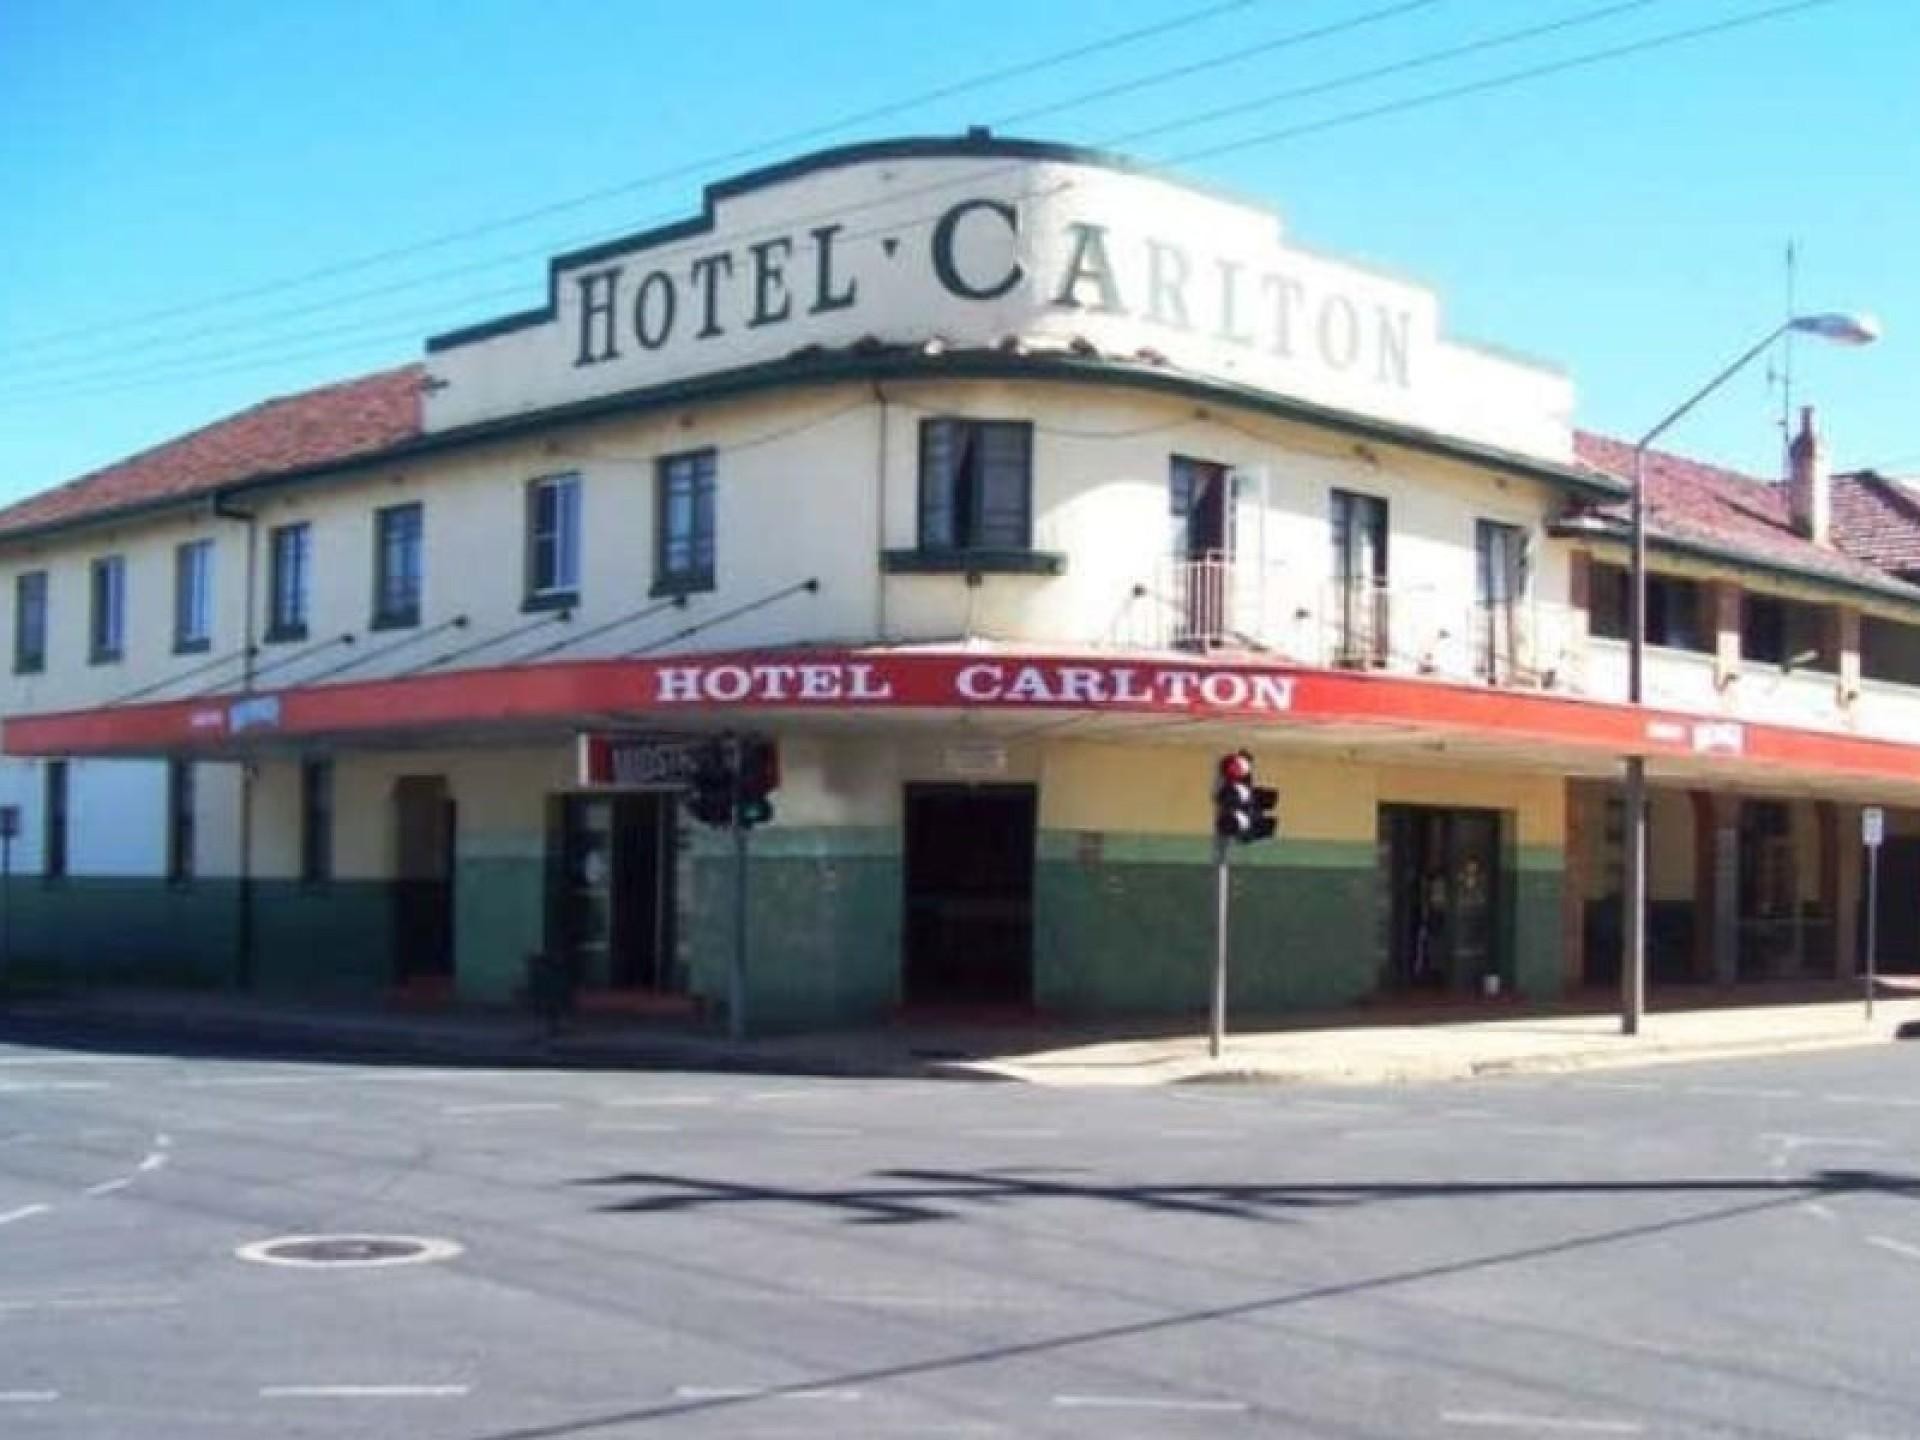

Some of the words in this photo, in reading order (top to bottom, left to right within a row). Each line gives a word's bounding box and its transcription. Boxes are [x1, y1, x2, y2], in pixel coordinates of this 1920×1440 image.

[573, 223, 857, 367] HOTEL
[930, 198, 1412, 389] CARLTON
[656, 664, 892, 702] HOTEL
[956, 664, 1296, 711] CARLTON
